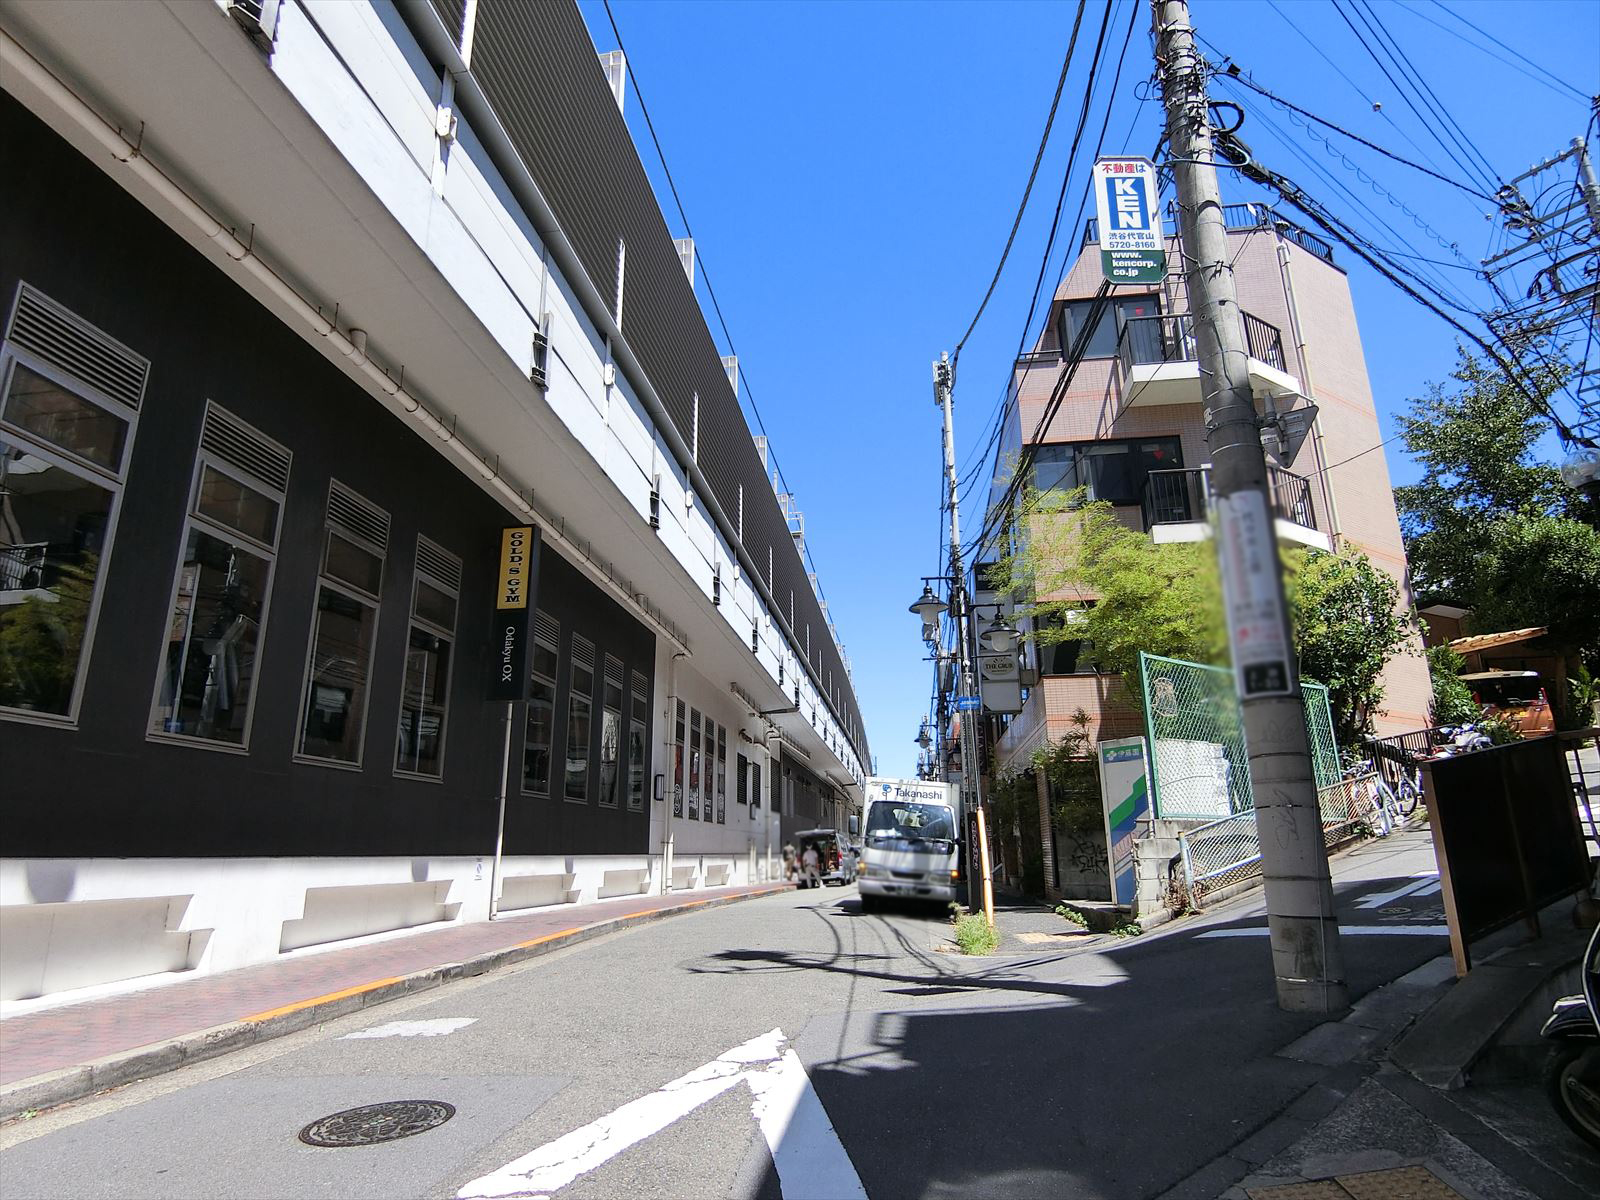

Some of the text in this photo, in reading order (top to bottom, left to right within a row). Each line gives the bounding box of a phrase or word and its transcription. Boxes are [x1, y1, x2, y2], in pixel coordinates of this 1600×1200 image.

[1102, 163, 1146, 174] 不動産は
[1114, 178, 1143, 228] KEN
[1108, 232, 1155, 240] 渋谷代官山
[1109, 241, 1156, 249] 5720-8160
[1111, 251, 1142, 259] www.
[1112, 259, 1157, 269] kencorp.
[1113, 268, 1139, 277] co.jp
[505, 531, 525, 603] GOLD'S GYM
[501, 626, 516, 682] Odakyu OX
[894, 787, 943, 799] Takanashi
